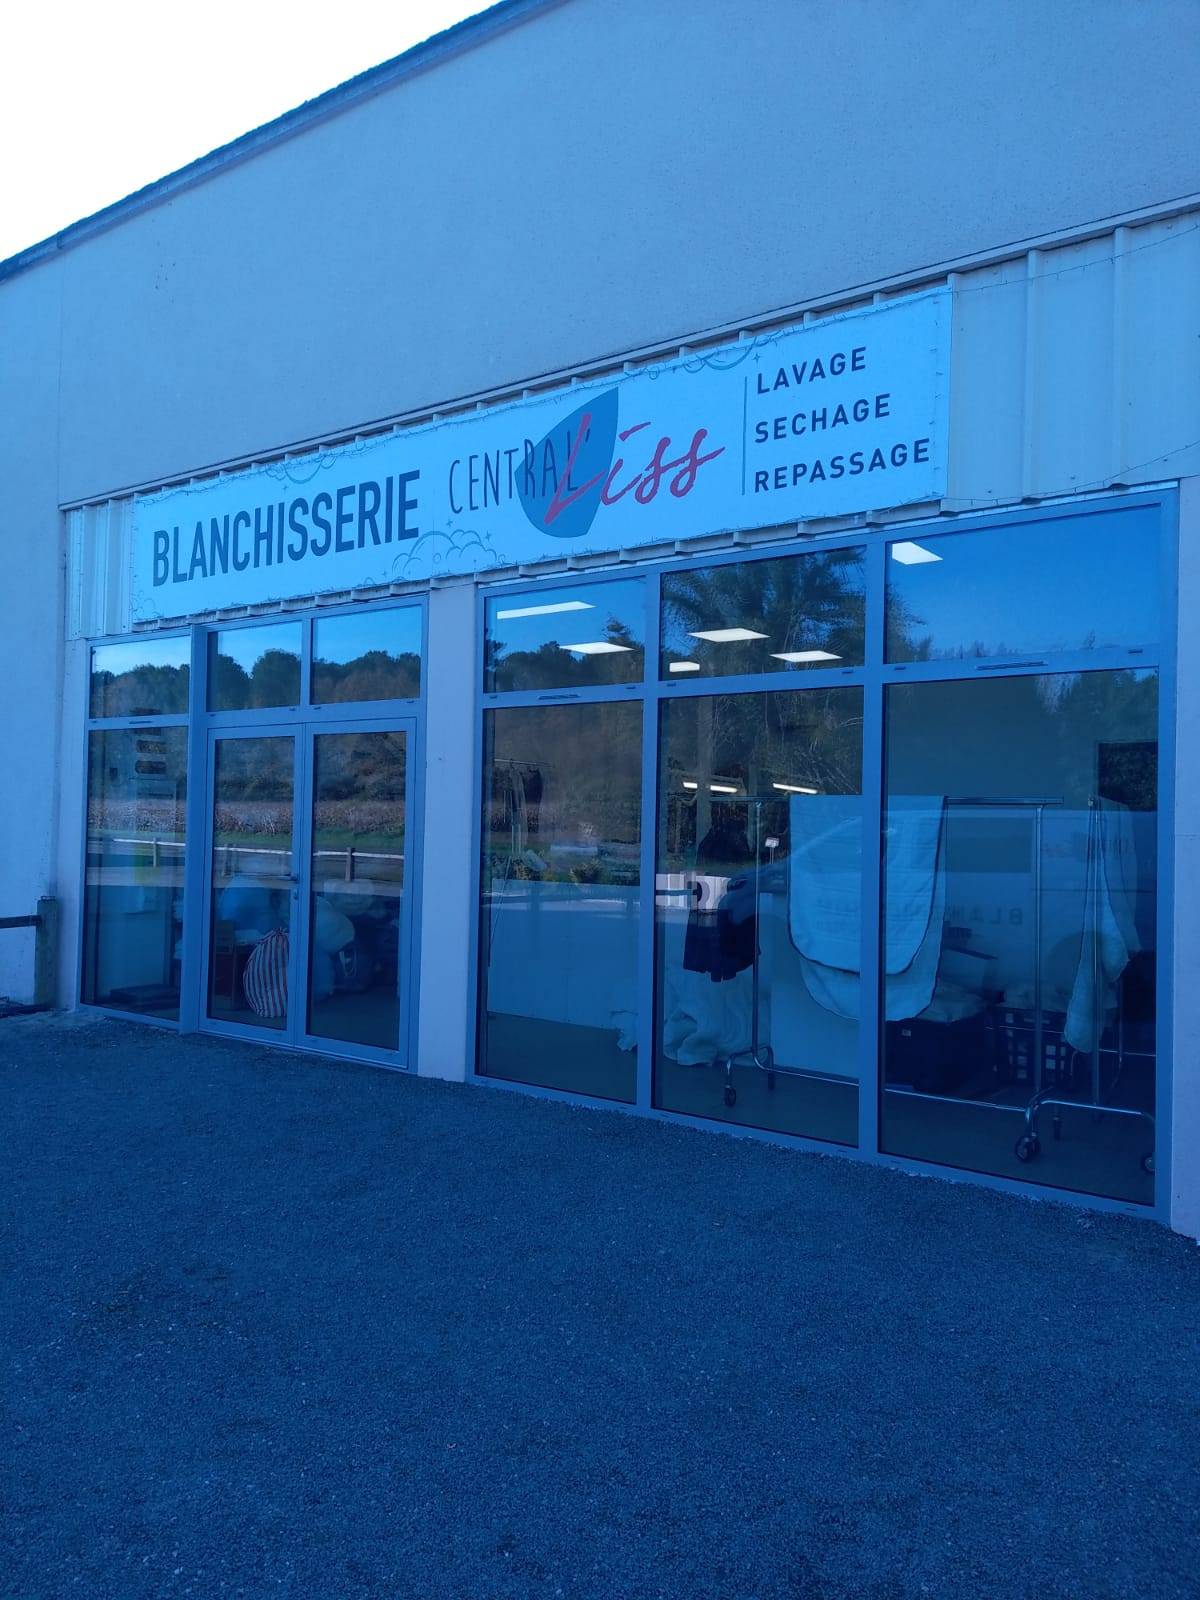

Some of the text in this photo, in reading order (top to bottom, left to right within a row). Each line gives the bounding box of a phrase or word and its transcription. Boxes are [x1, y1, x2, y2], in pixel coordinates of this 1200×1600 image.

[757, 346, 867, 395] LAVAGE
[754, 393, 891, 444] SECHAGE
[754, 437, 930, 494] REPASSAGE
[152, 469, 421, 588] BLANCHISSERIE
[544, 411, 726, 525] Liss
